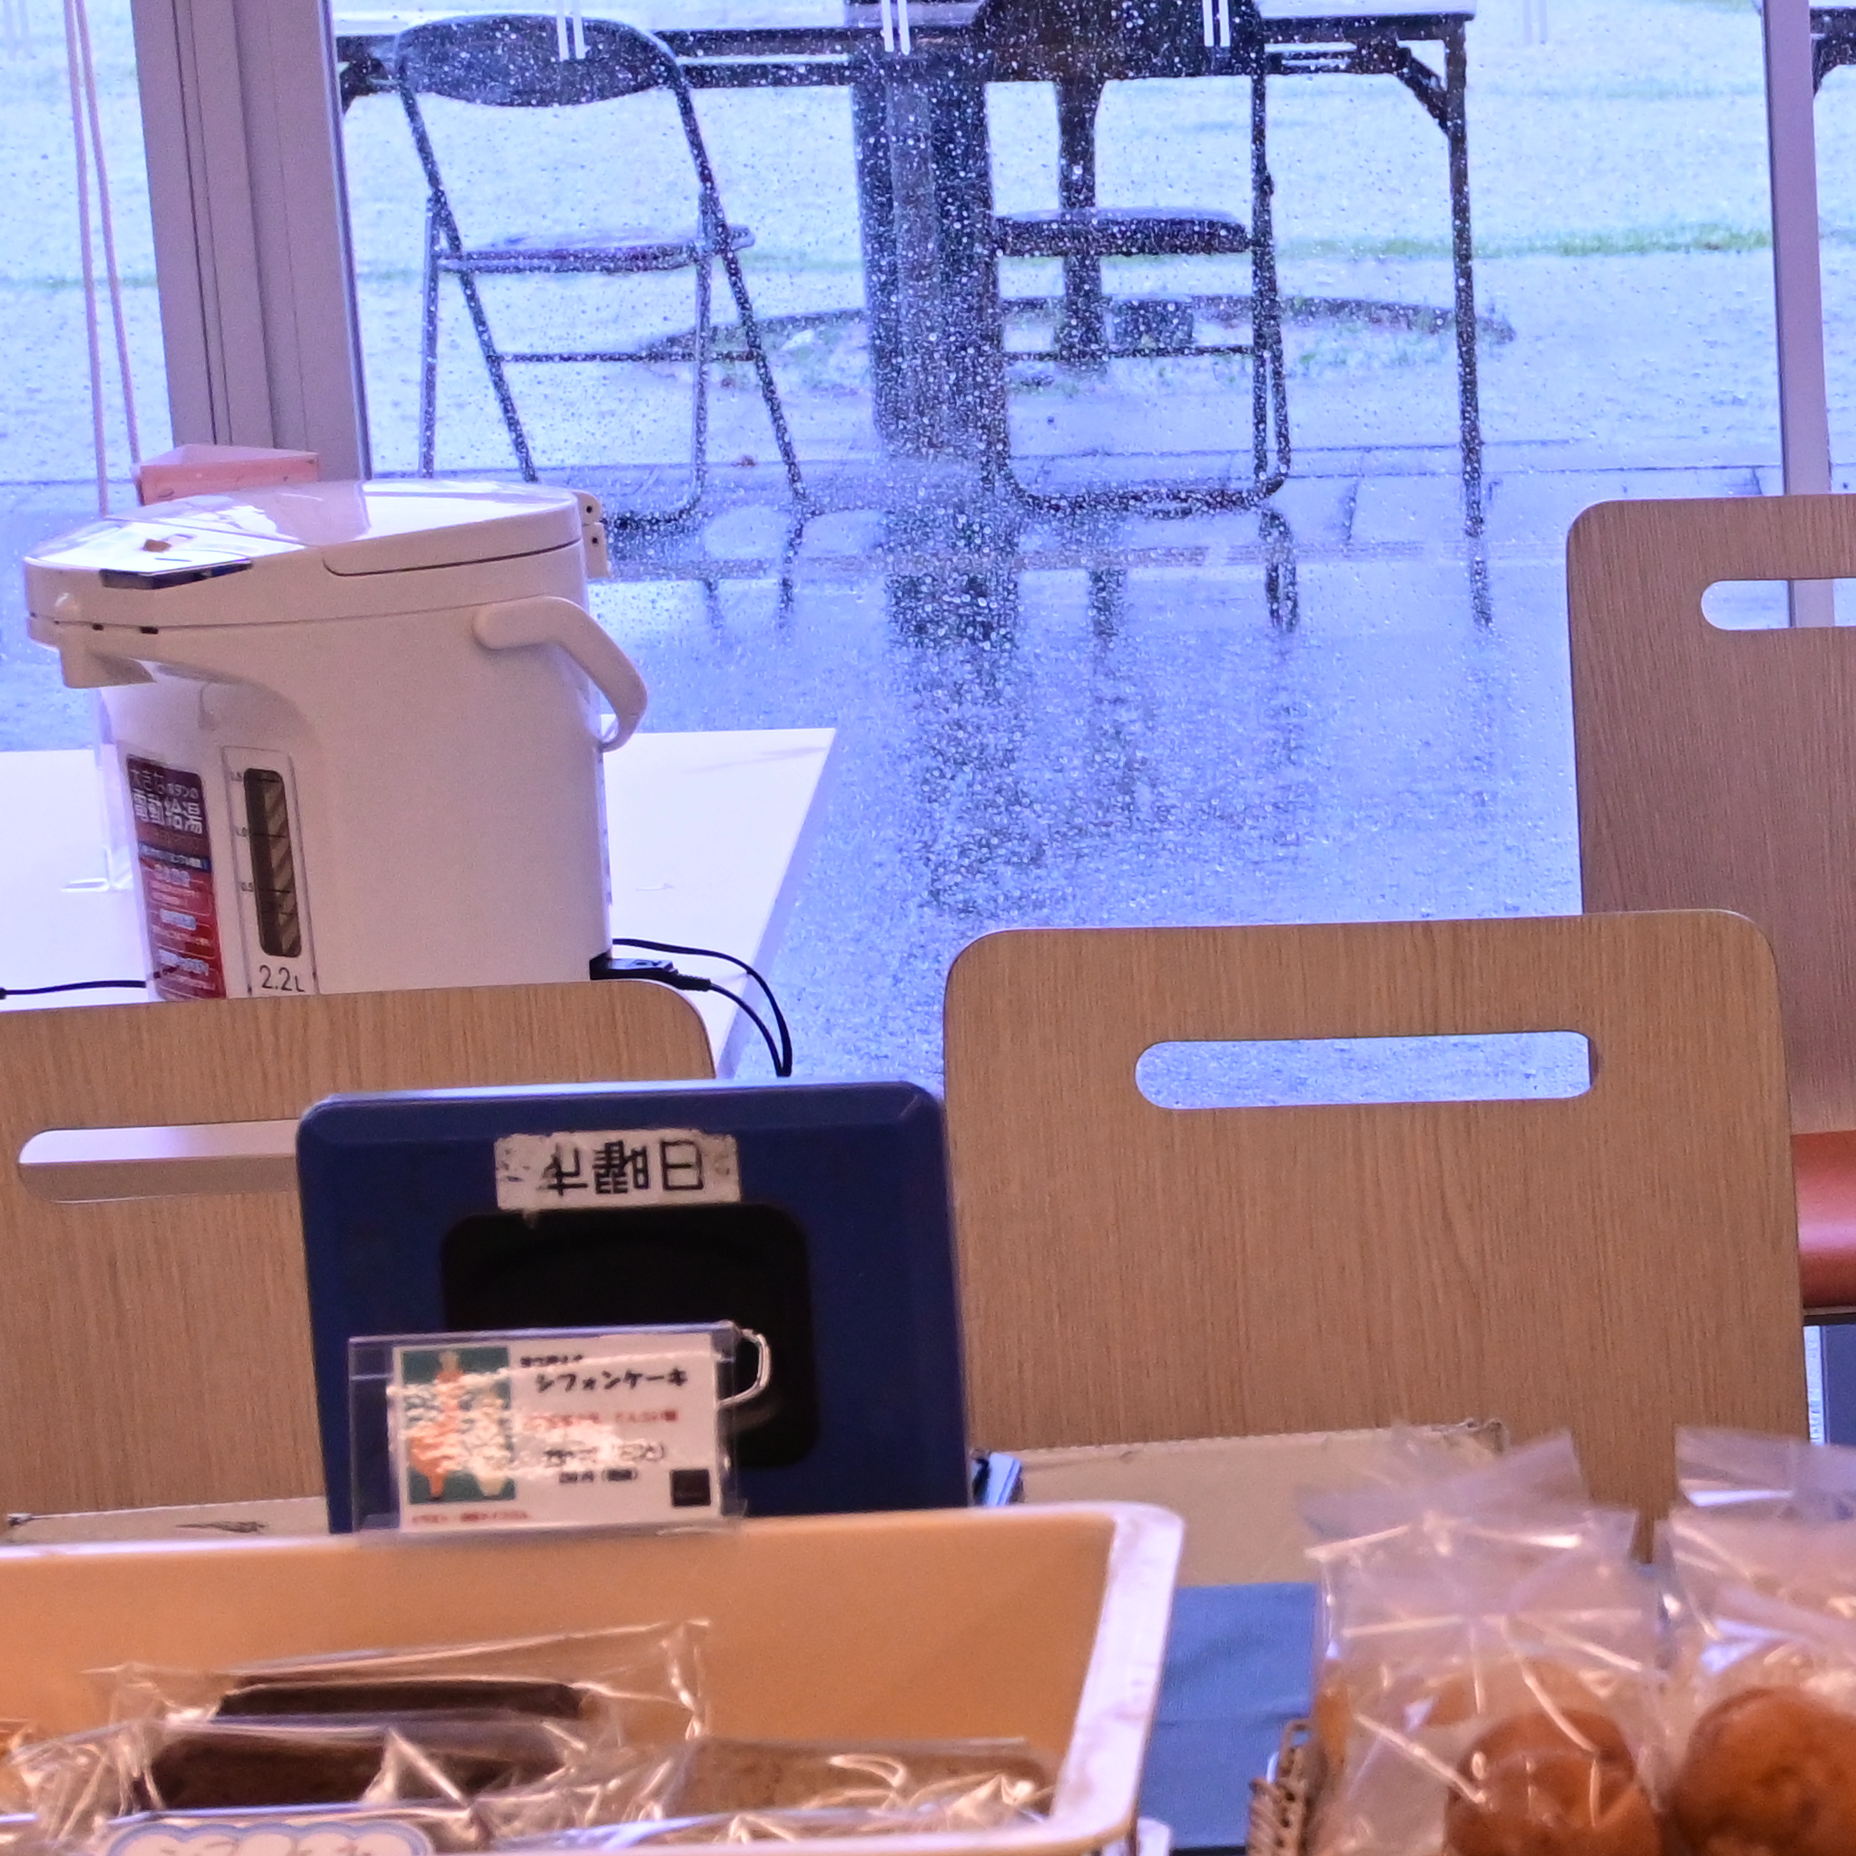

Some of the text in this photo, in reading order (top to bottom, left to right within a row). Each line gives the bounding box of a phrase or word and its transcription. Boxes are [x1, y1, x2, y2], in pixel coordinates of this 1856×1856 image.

[258, 964, 306, 993] 2.2L
[535, 1368, 689, 1393] シフォンケーキ
